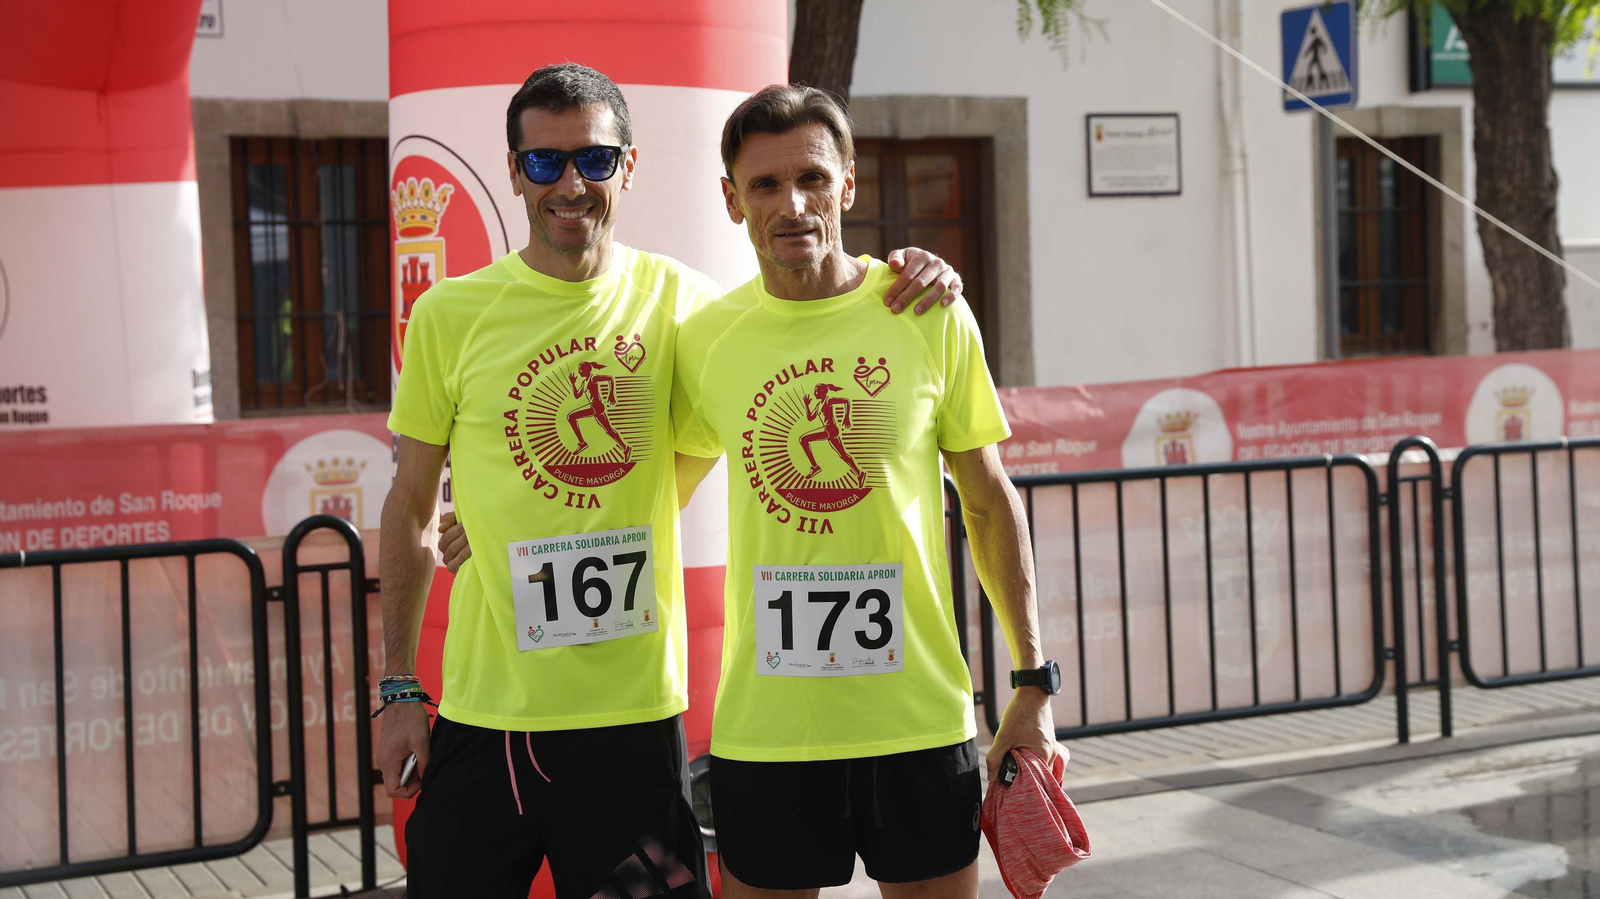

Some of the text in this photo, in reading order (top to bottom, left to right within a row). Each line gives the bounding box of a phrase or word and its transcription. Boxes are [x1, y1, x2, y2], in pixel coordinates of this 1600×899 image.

[503, 337, 602, 509] VII CARRERA POPULAR
[1277, 417, 1359, 440] Ayuntamiento
[1361, 414, 1376, 431] de
[1376, 412, 1401, 429] San
[1403, 410, 1442, 430] Roque
[741, 357, 835, 534] VII CARRERA POPULAR
[1006, 442, 1025, 459] de
[1026, 440, 1053, 458] San
[1054, 438, 1098, 459] Roque
[553, 467, 626, 485] PUENTE MAYORGA
[90, 494, 115, 517] de
[119, 492, 156, 514] San
[161, 490, 223, 516] Roque
[785, 492, 860, 511] PUENTE MAYORGA
[26, 527, 57, 551] DE
[60, 520, 171, 549] DEPORTES
[516, 531, 647, 558] VII CARRERA SOLIDARIA APRON
[527, 550, 647, 622] 167
[761, 568, 896, 582] VII CARRERA SOLIDARIA APRON
[768, 588, 893, 651] 173
